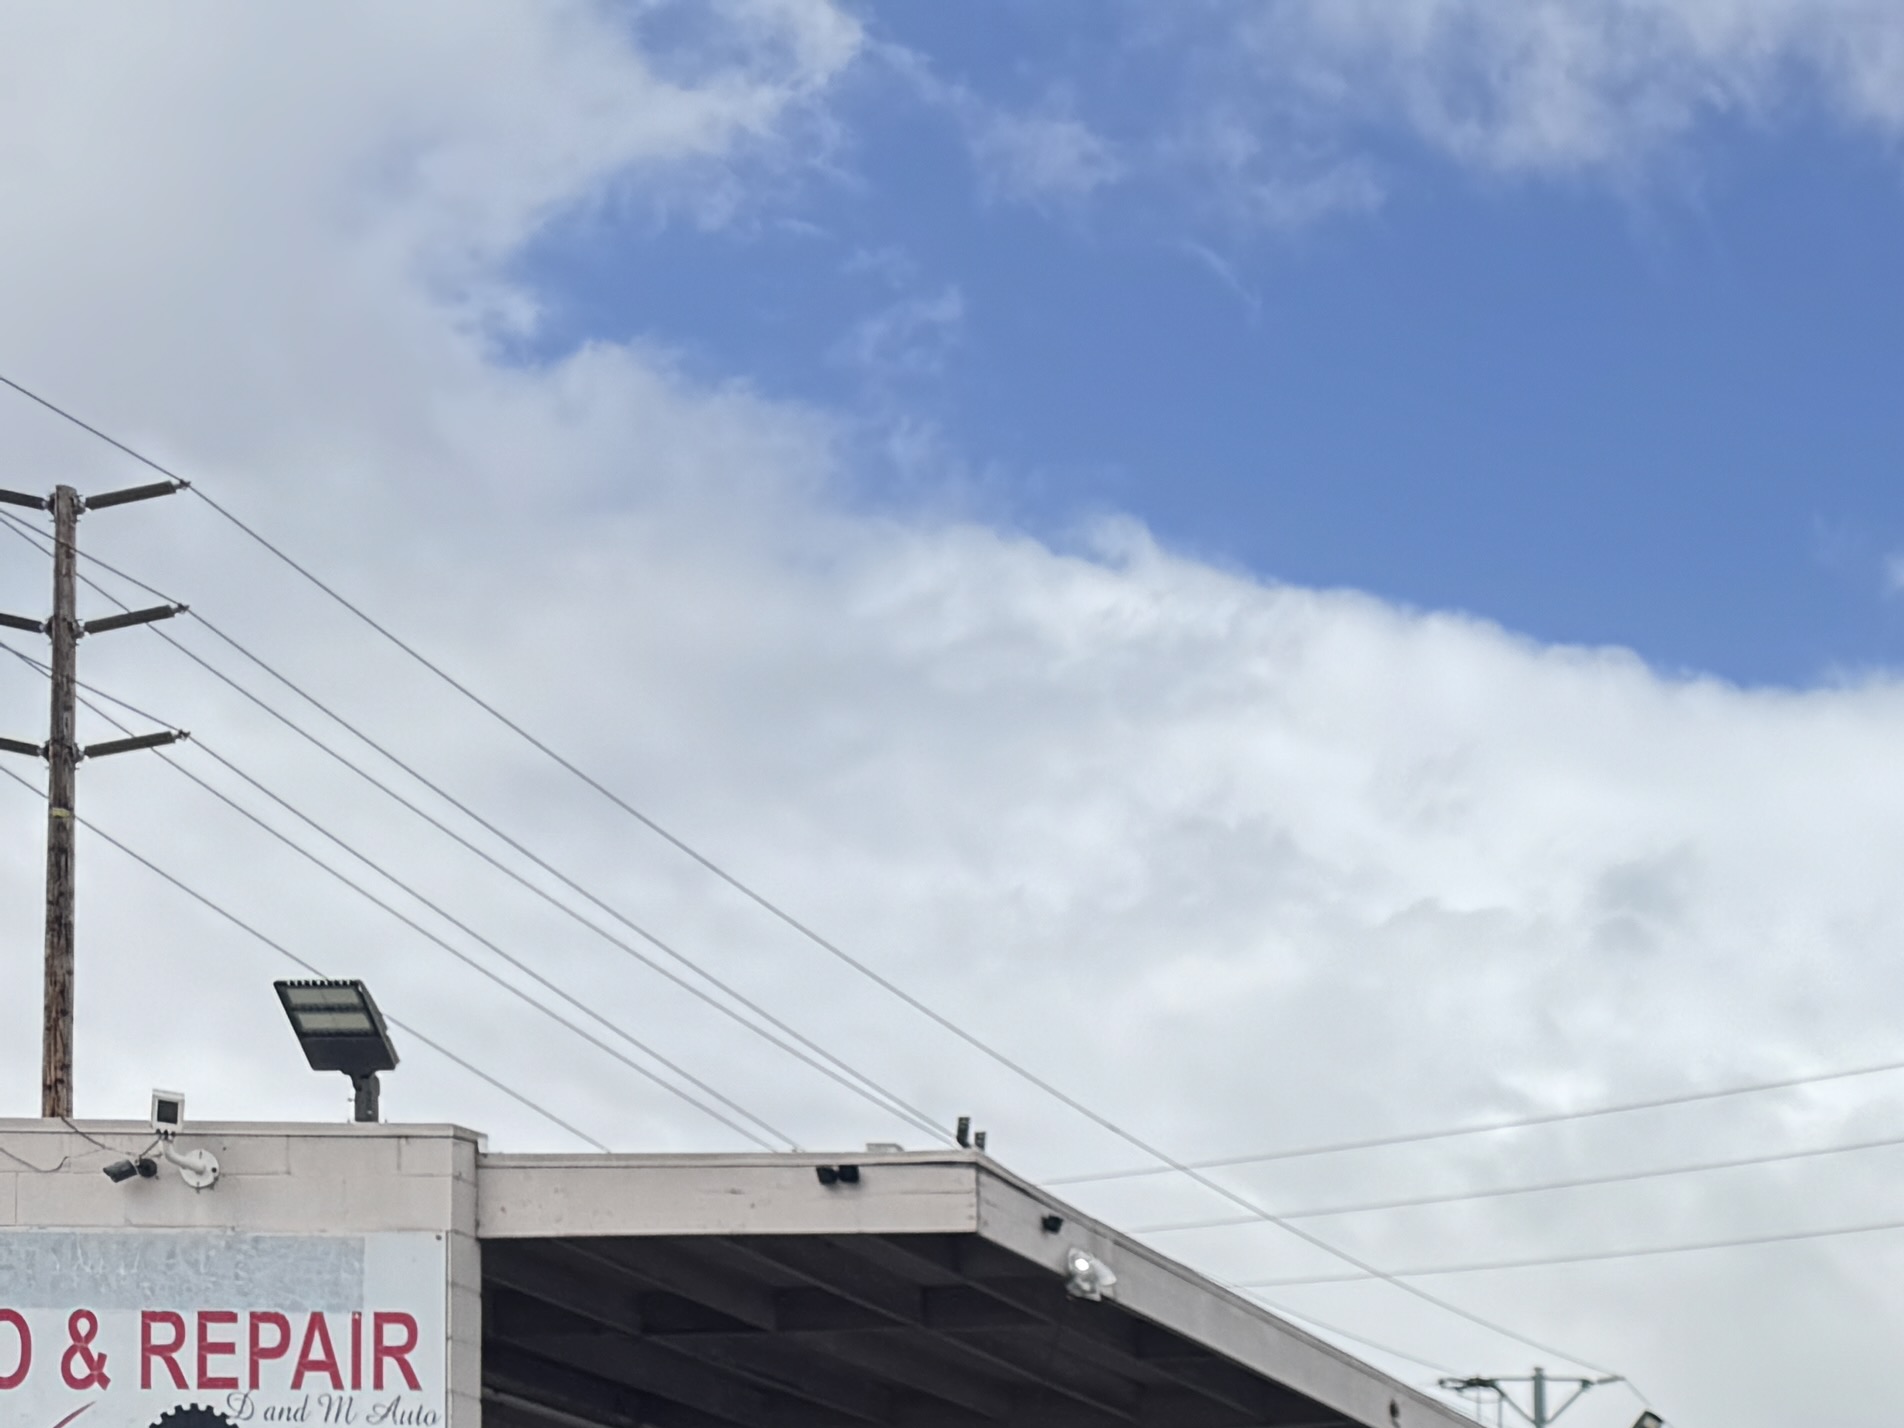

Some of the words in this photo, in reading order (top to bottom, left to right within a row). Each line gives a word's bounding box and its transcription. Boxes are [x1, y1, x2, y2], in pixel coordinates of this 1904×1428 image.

[61, 1309, 111, 1391] &
[140, 1311, 423, 1392] REPAIR
[263, 1394, 311, 1422] and
[317, 1393, 358, 1425] M
[366, 1395, 442, 1427] Auto
